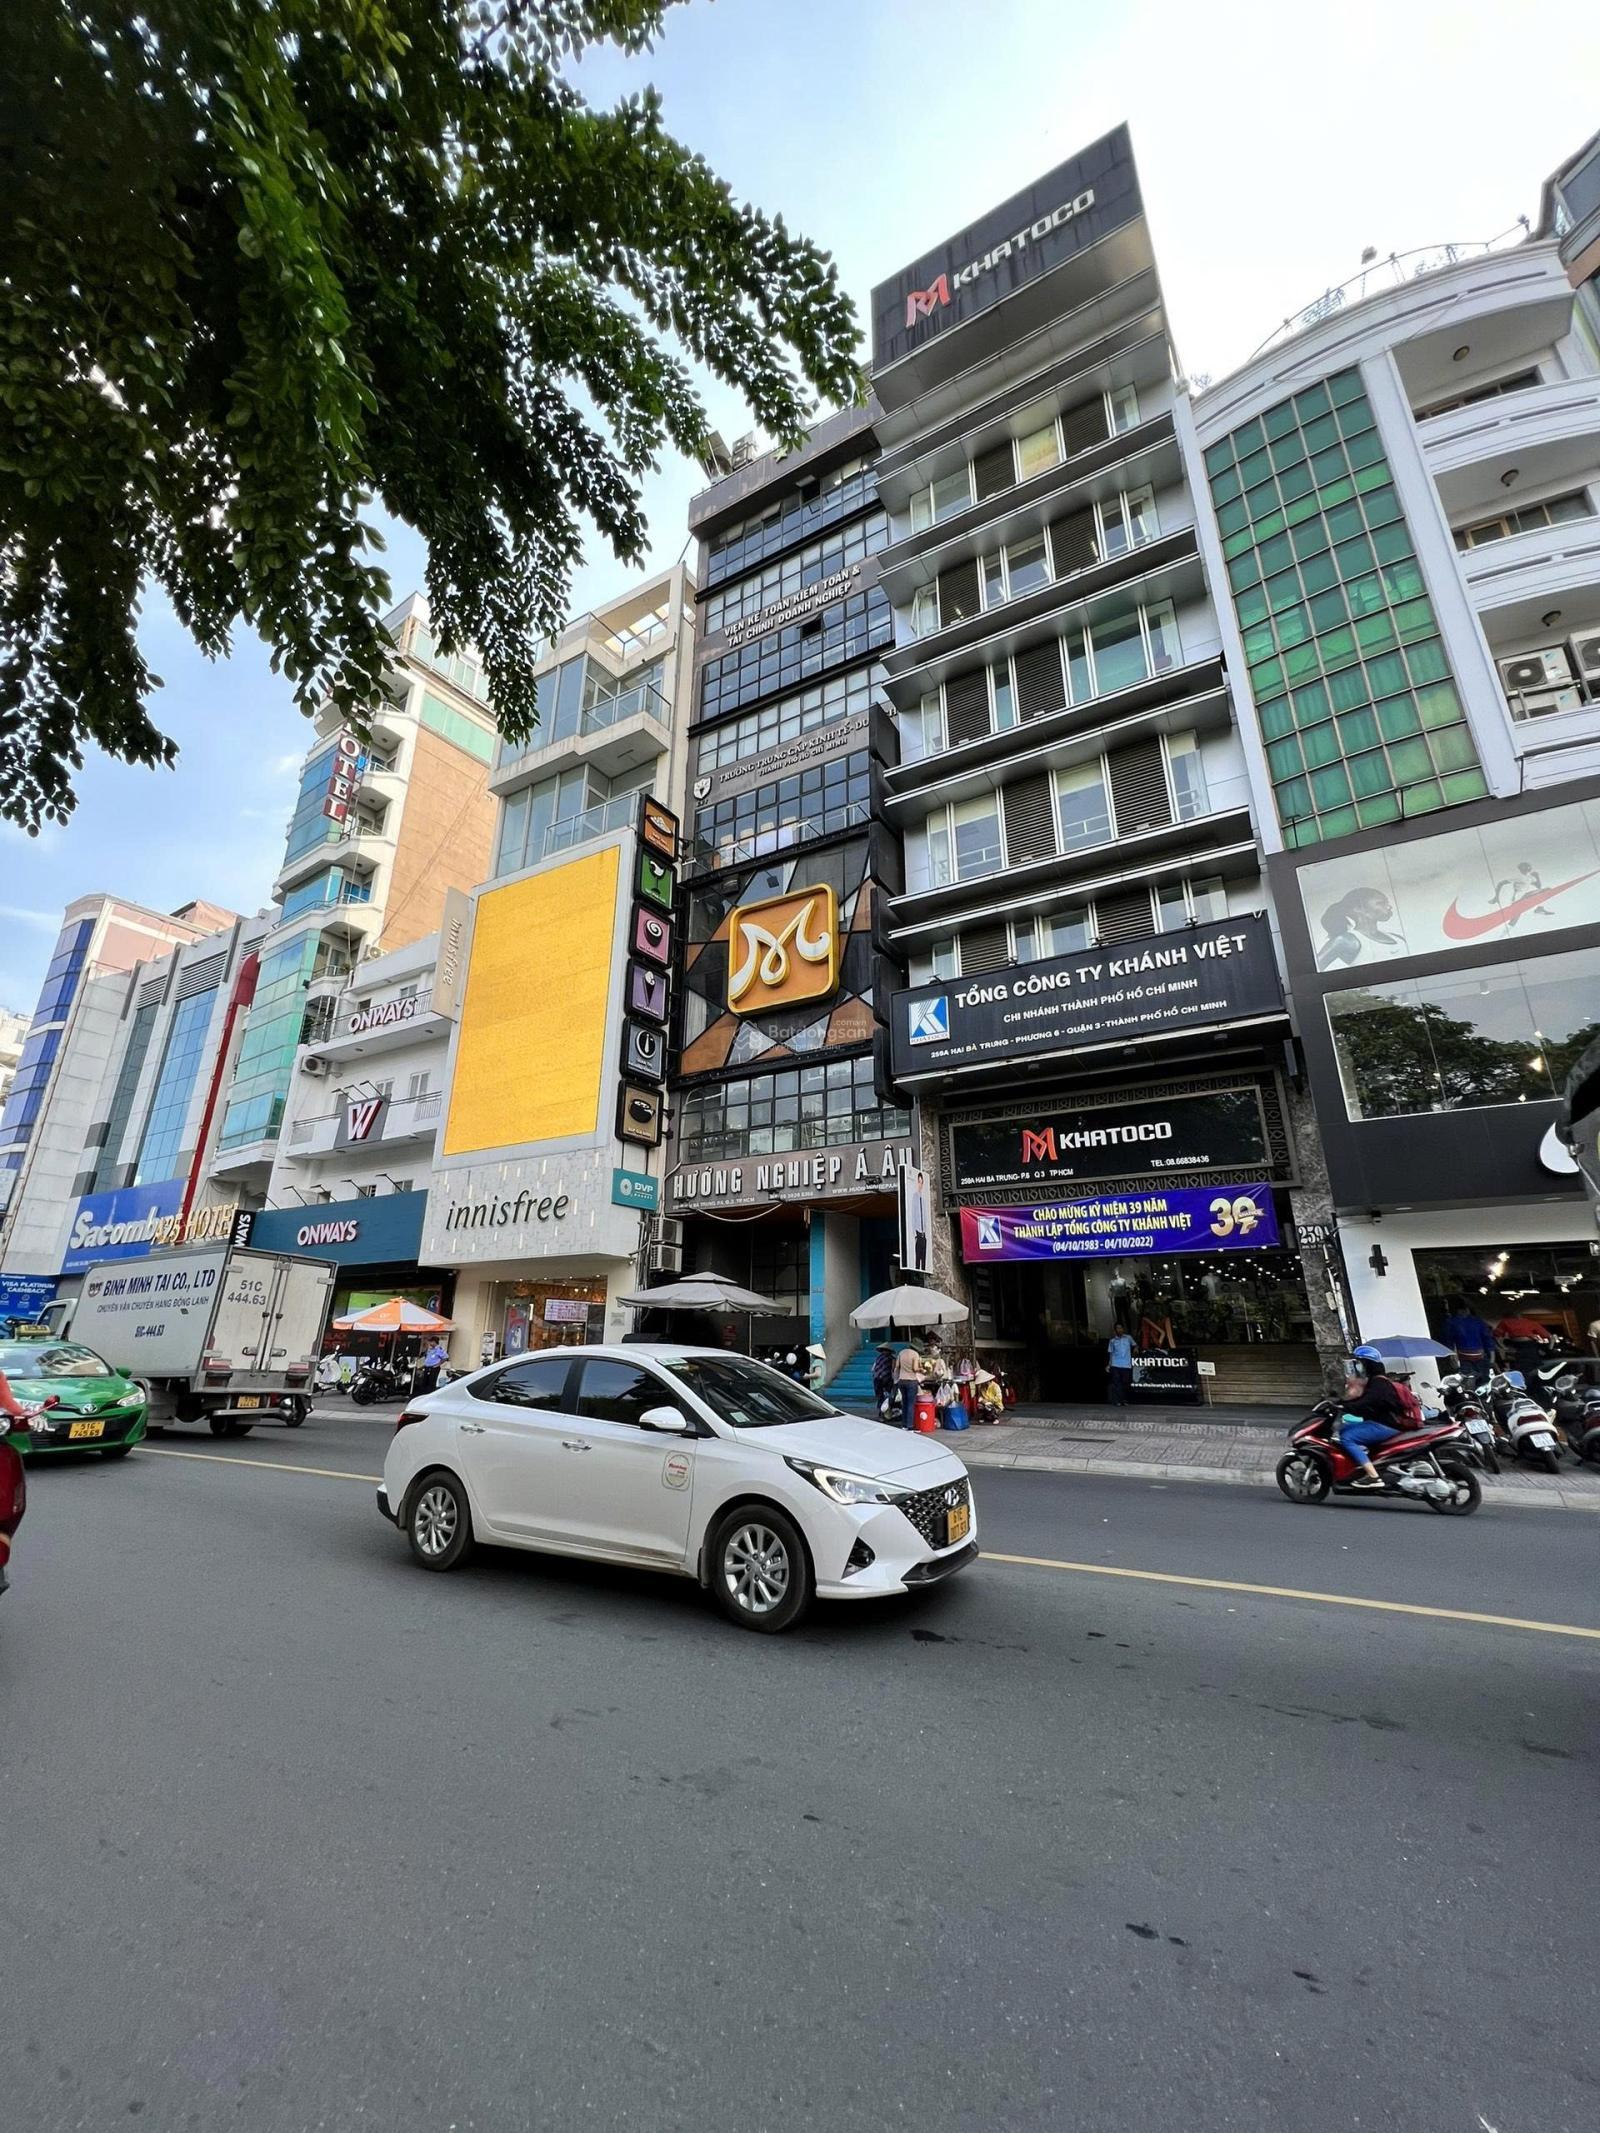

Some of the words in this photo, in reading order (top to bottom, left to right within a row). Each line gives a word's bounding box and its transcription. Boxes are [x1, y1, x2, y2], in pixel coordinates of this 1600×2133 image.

[953, 189, 1094, 290] KHATOCO
[852, 565, 861, 576] &
[778, 600, 811, 623] DOANH
[756, 750, 787, 770] TRUNG
[809, 732, 836, 749] KINH
[443, 918, 463, 986] innisfree
[955, 983, 1008, 1009] TỔNG
[1012, 972, 1072, 998] CÔNG
[1076, 965, 1102, 984] TY
[1109, 947, 1187, 978] KHÁNH
[1193, 934, 1247, 959] VIỆT
[350, 998, 417, 1033] ONWAYS
[1003, 1012, 1021, 1023] CHI
[1023, 1005, 1059, 1020] NHÁNH
[1061, 997, 1098, 1012] THÀNH
[1100, 990, 1124, 1005] PHỐ
[1126, 985, 1143, 999] HỒ
[1145, 982, 1166, 997] CHÍ
[1168, 979, 1198, 993] MINH
[950, 1047, 965, 1056] HAI
[966, 1043, 978, 1053] BÀ
[1066, 1023, 1093, 1034] QUẬN
[1140, 1009, 1161, 1021] PHỐ
[1163, 1005, 1179, 1017] HỒ
[1200, 1000, 1227, 1012] MINH
[1060, 1121, 1172, 1150] KHATOCO
[673, 1165, 743, 1199] HƯỚNG
[756, 1152, 843, 1191] NGHIỆP
[854, 1148, 869, 1180] Á
[445, 1189, 570, 1231] innisfree
[1033, 1206, 1057, 1222] CHÀO
[1058, 1203, 1088, 1219] MỪNG
[1089, 1201, 1101, 1217] KỶ
[1102, 1200, 1128, 1219] NIỆM
[1129, 1201, 1142, 1214] 39
[1143, 1197, 1168, 1212] NĂM
[70, 1206, 160, 1250] Sacomb
[297, 1219, 357, 1246] ONWAYS
[1014, 1224, 1045, 1239] THÀNH
[1046, 1222, 1063, 1240] LẬP
[1064, 1219, 1090, 1236] TỔNG
[1091, 1218, 1117, 1235] CÔNG
[1118, 1218, 1131, 1231] TY
[1132, 1215, 1168, 1232] KHÁNH
[1169, 1212, 1192, 1231] VIỆT
[1052, 1239, 1099, 1253] (04/10/1983
[1104, 1235, 1154, 1250] 04/10/2022)
[127, 1275, 154, 1294] MINH
[172, 1272, 190, 1293] CO.,
[240, 1280, 263, 1291] 51C
[228, 1291, 267, 1306] 444.63
[1131, 1357, 1189, 1367] KHATOCO
